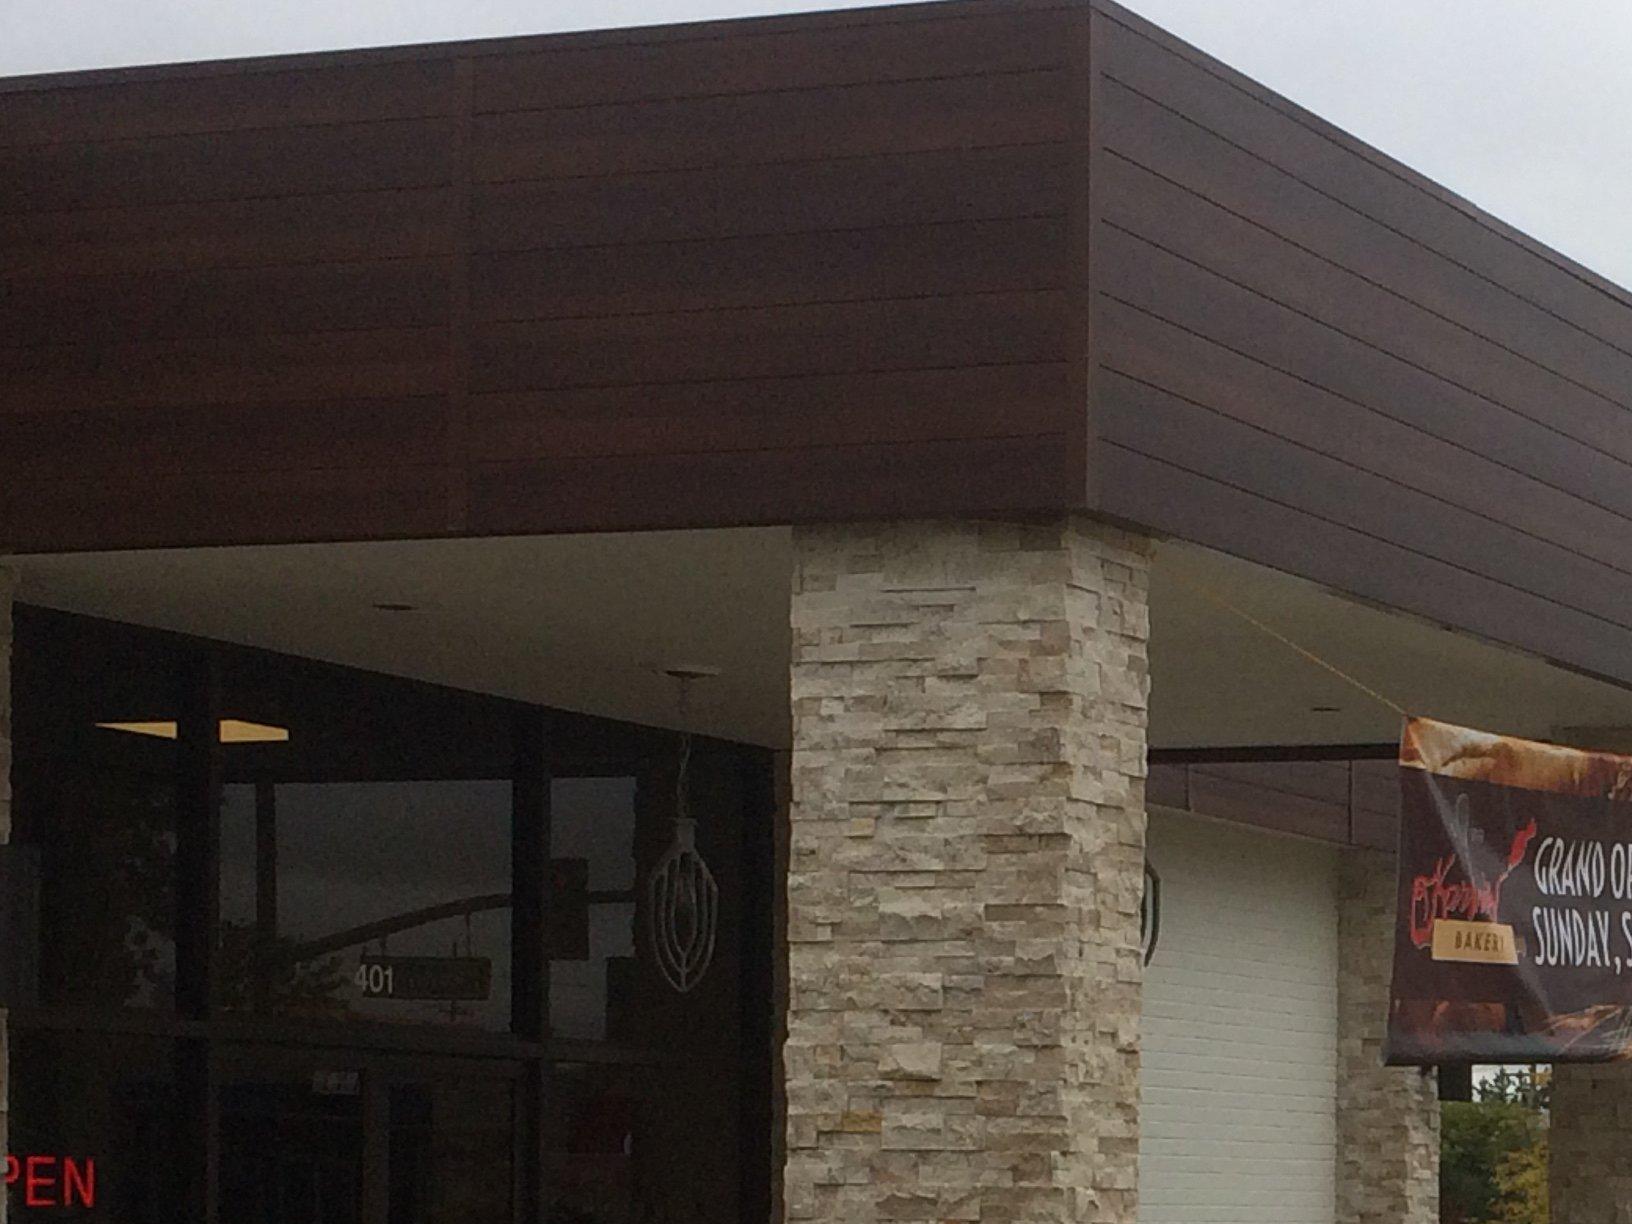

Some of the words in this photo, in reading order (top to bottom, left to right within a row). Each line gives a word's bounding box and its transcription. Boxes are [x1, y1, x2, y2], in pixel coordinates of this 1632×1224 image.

[1534, 837, 1604, 898] GRAND
[1532, 906, 1621, 975] SUNDAY,
[354, 964, 394, 995] 401
